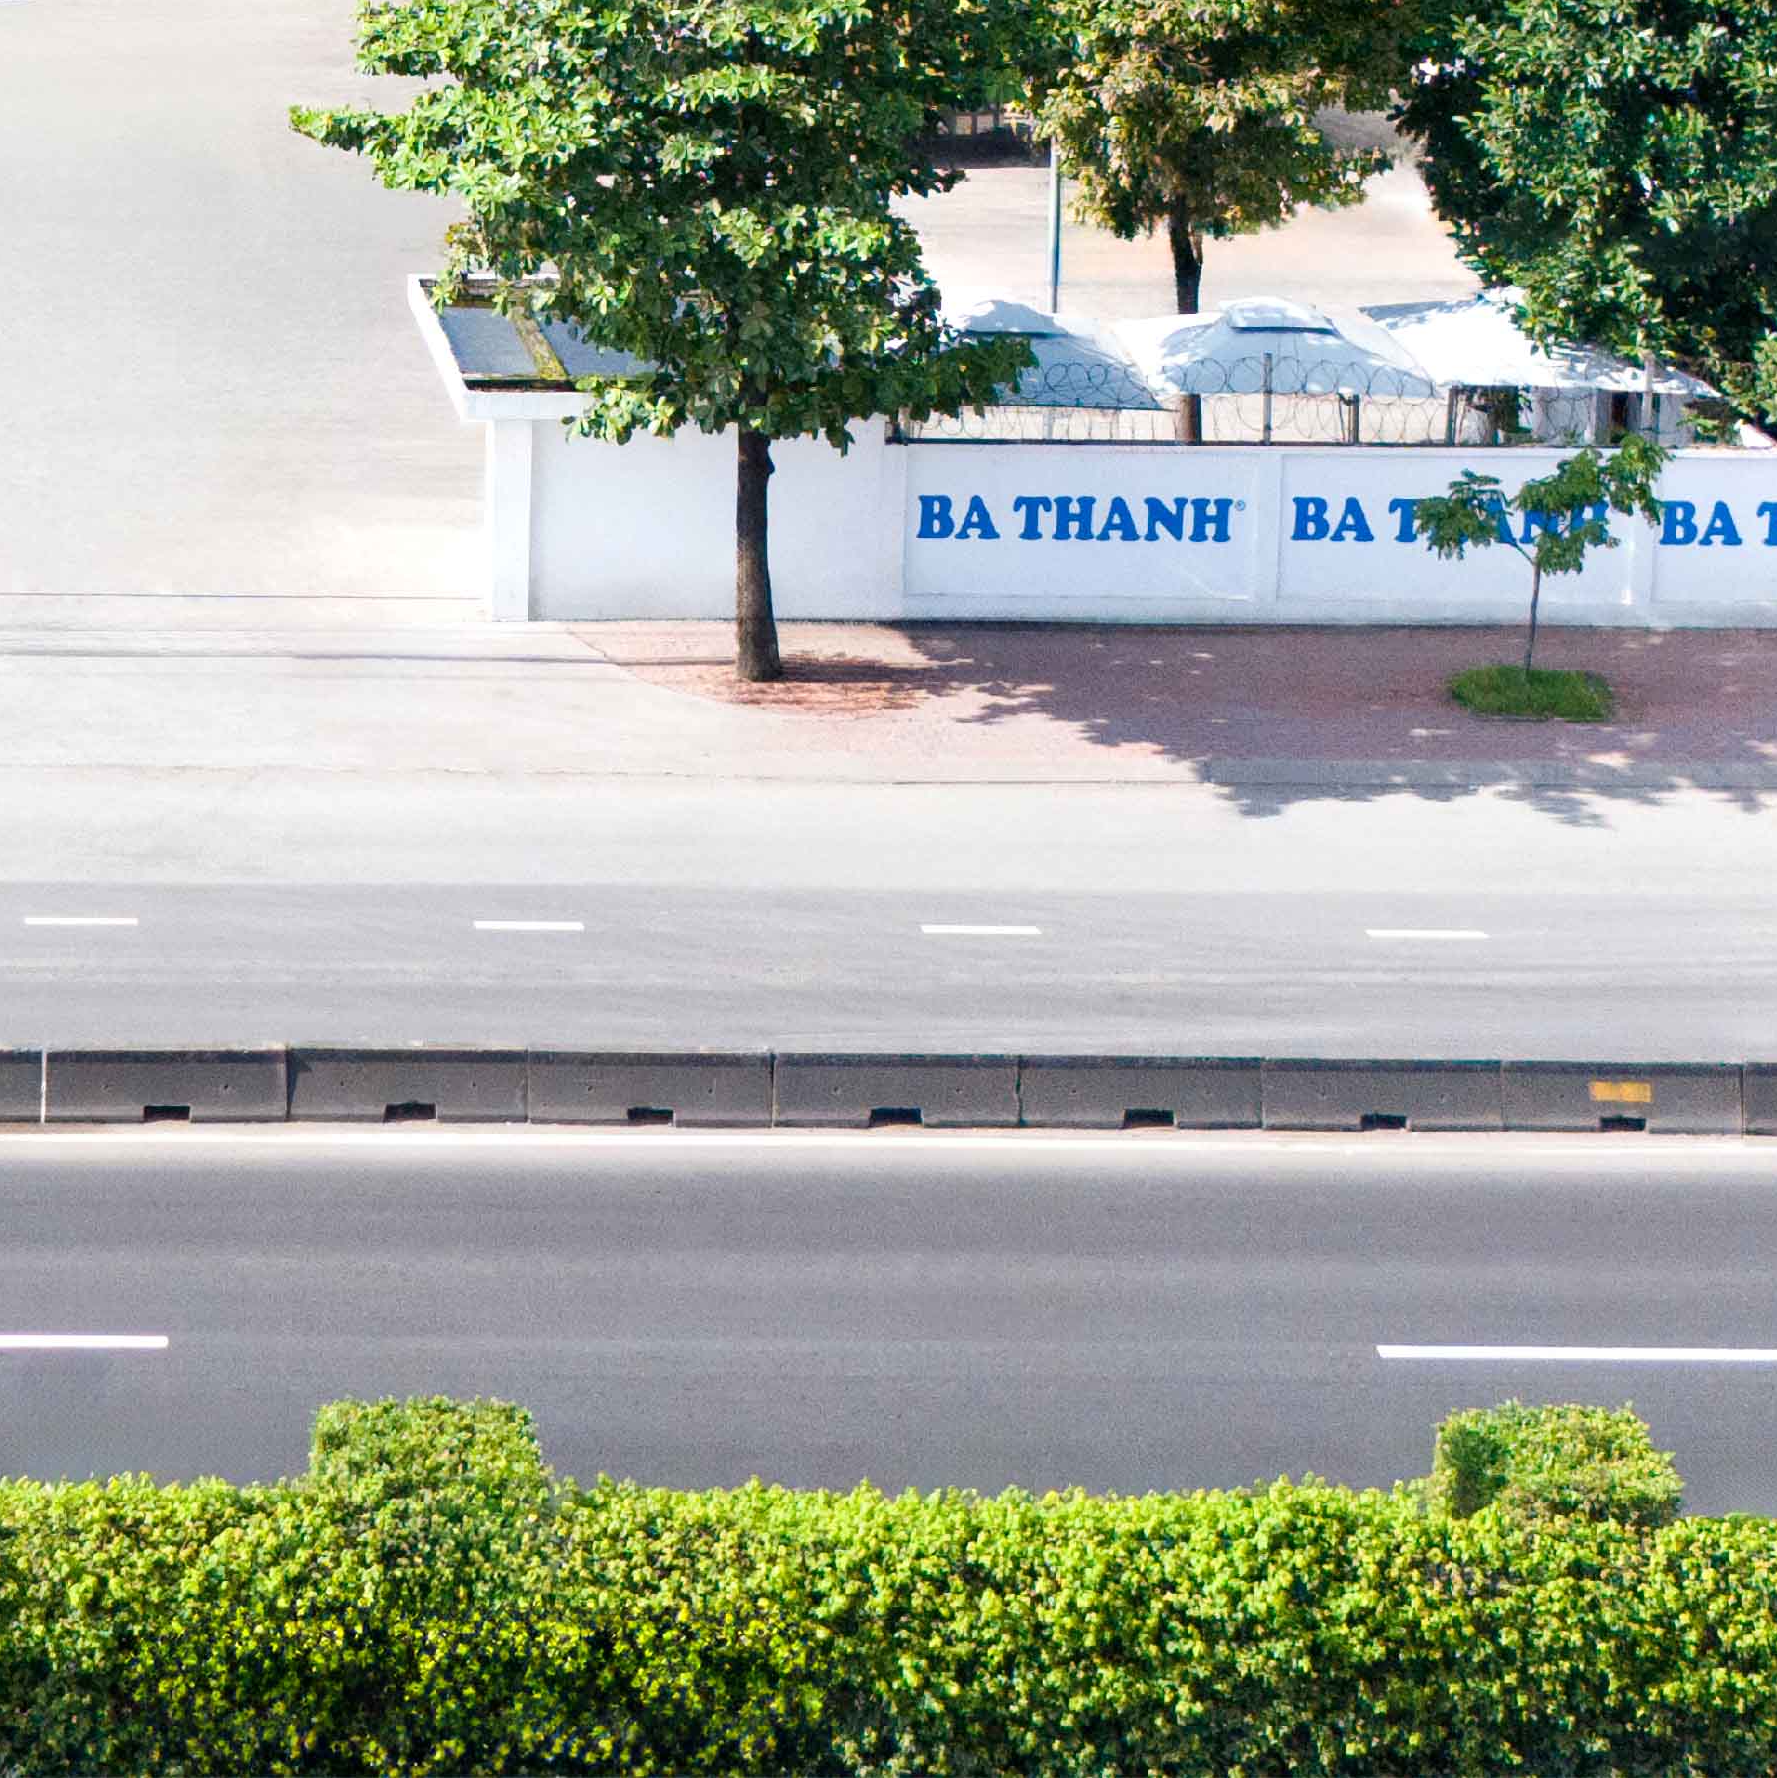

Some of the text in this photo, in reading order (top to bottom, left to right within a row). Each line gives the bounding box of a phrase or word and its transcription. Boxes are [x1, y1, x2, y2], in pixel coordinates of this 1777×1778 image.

[916, 494, 1000, 540] BA
[1290, 496, 1375, 542] BA
[1659, 500, 1743, 546] BA
